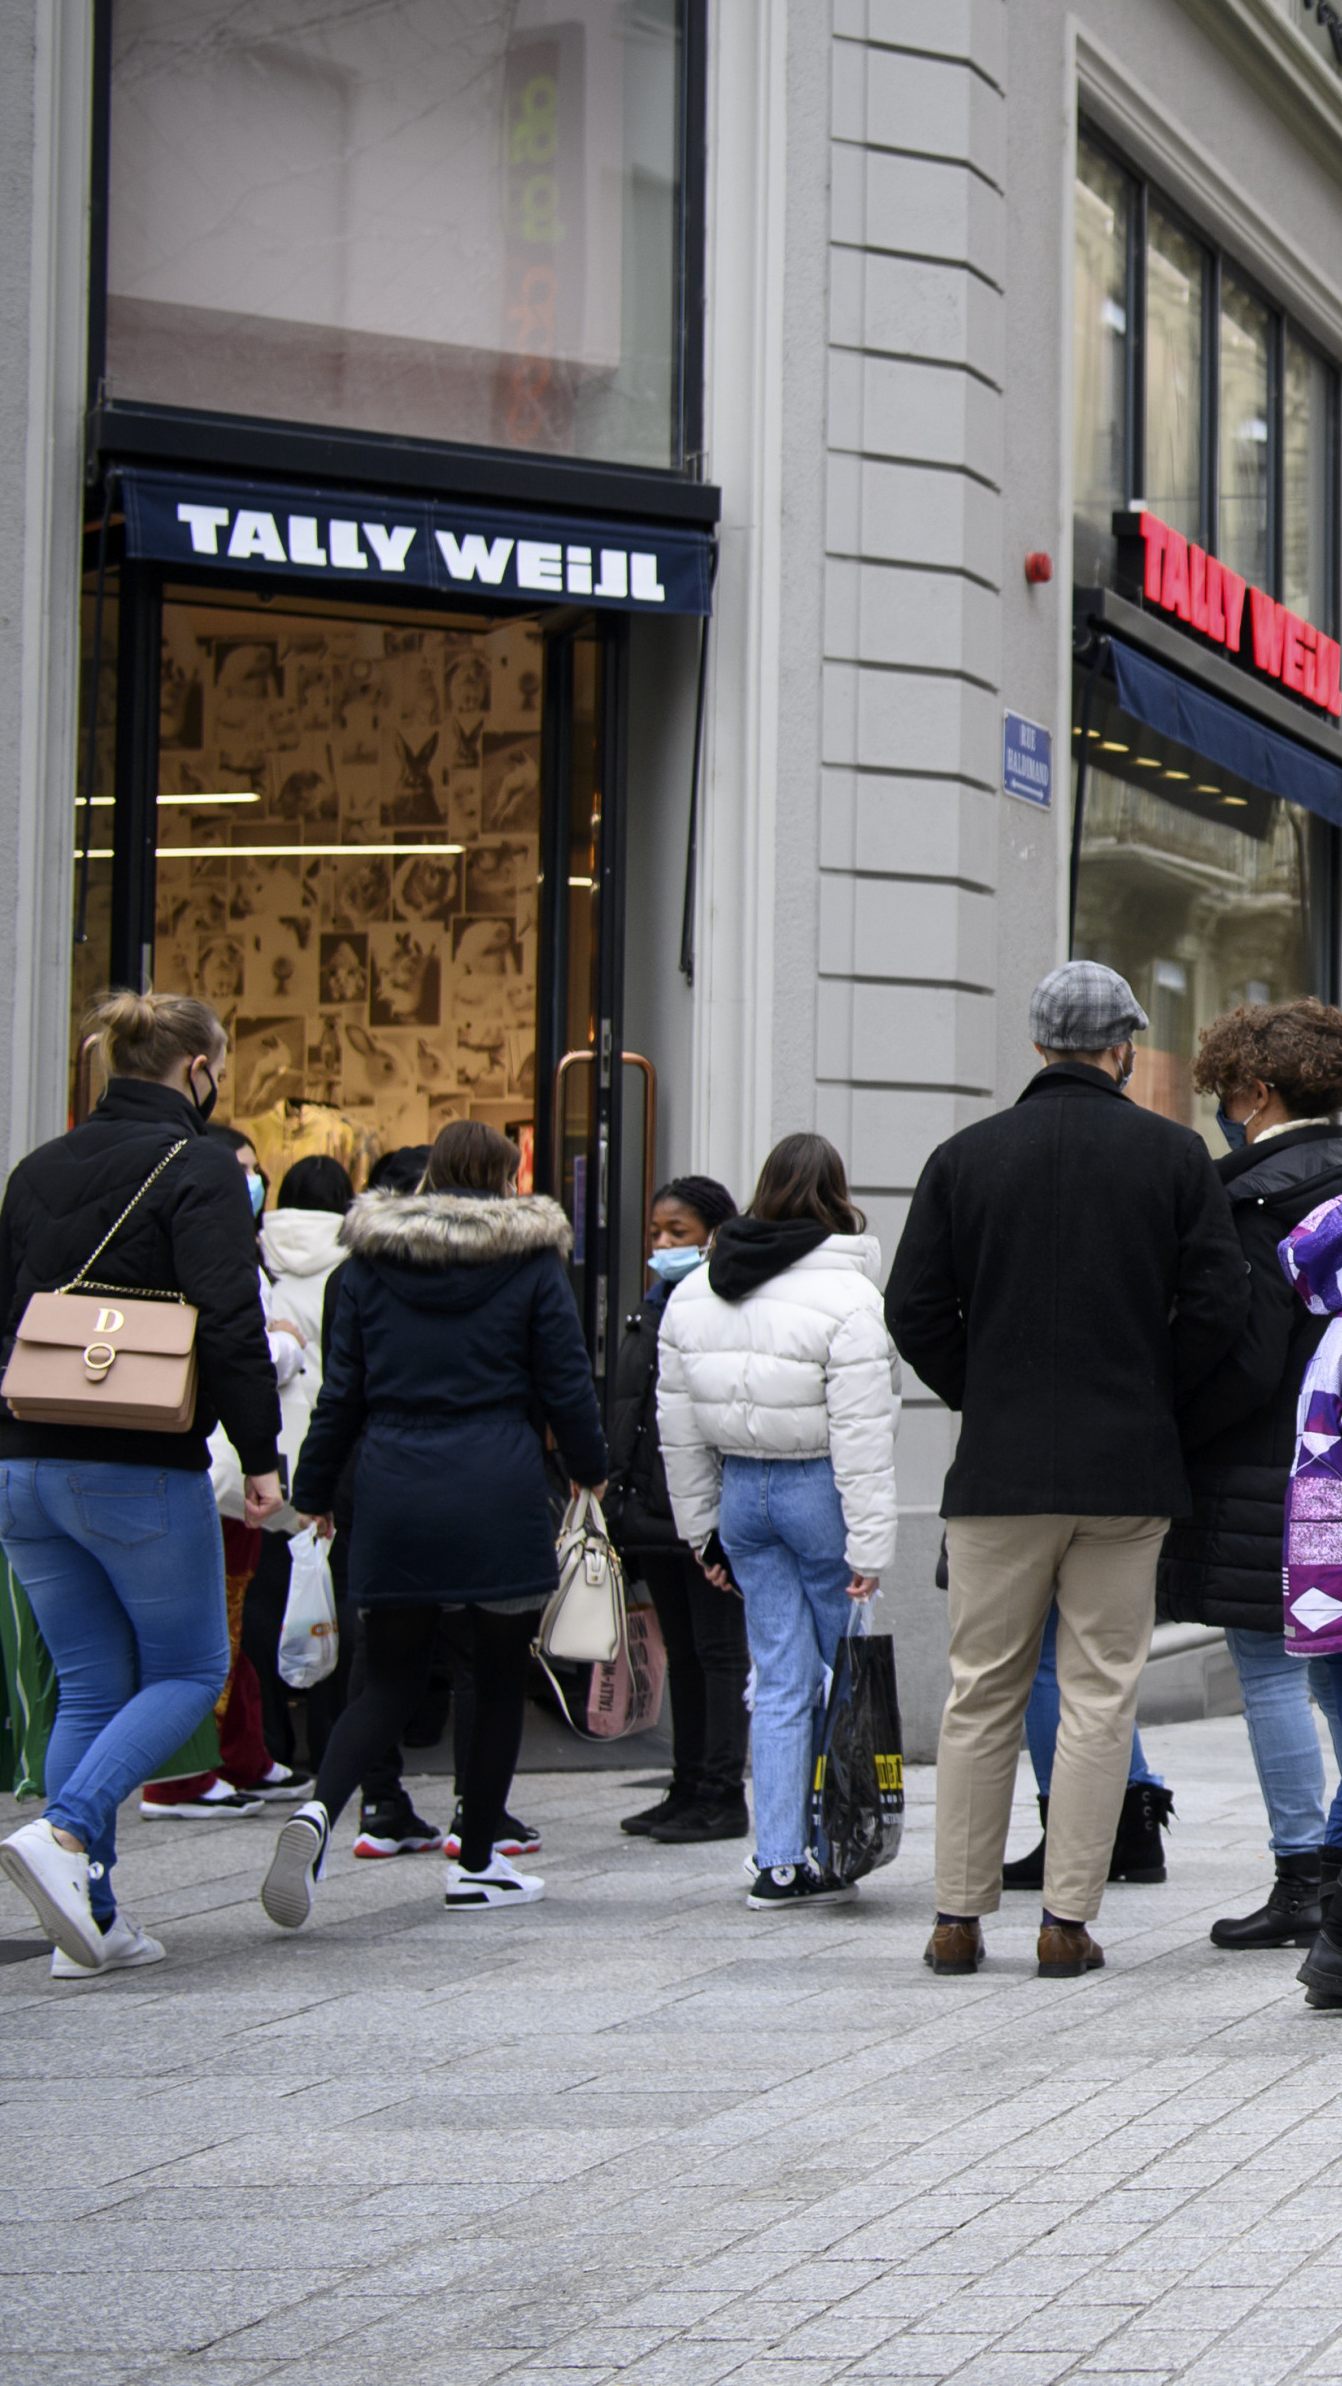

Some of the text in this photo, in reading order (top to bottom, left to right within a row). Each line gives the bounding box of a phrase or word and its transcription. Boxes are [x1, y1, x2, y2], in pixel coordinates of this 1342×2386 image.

[177, 503, 416, 572] TALLY
[1140, 510, 1246, 652] TALLY
[93, 1307, 125, 1333] D
